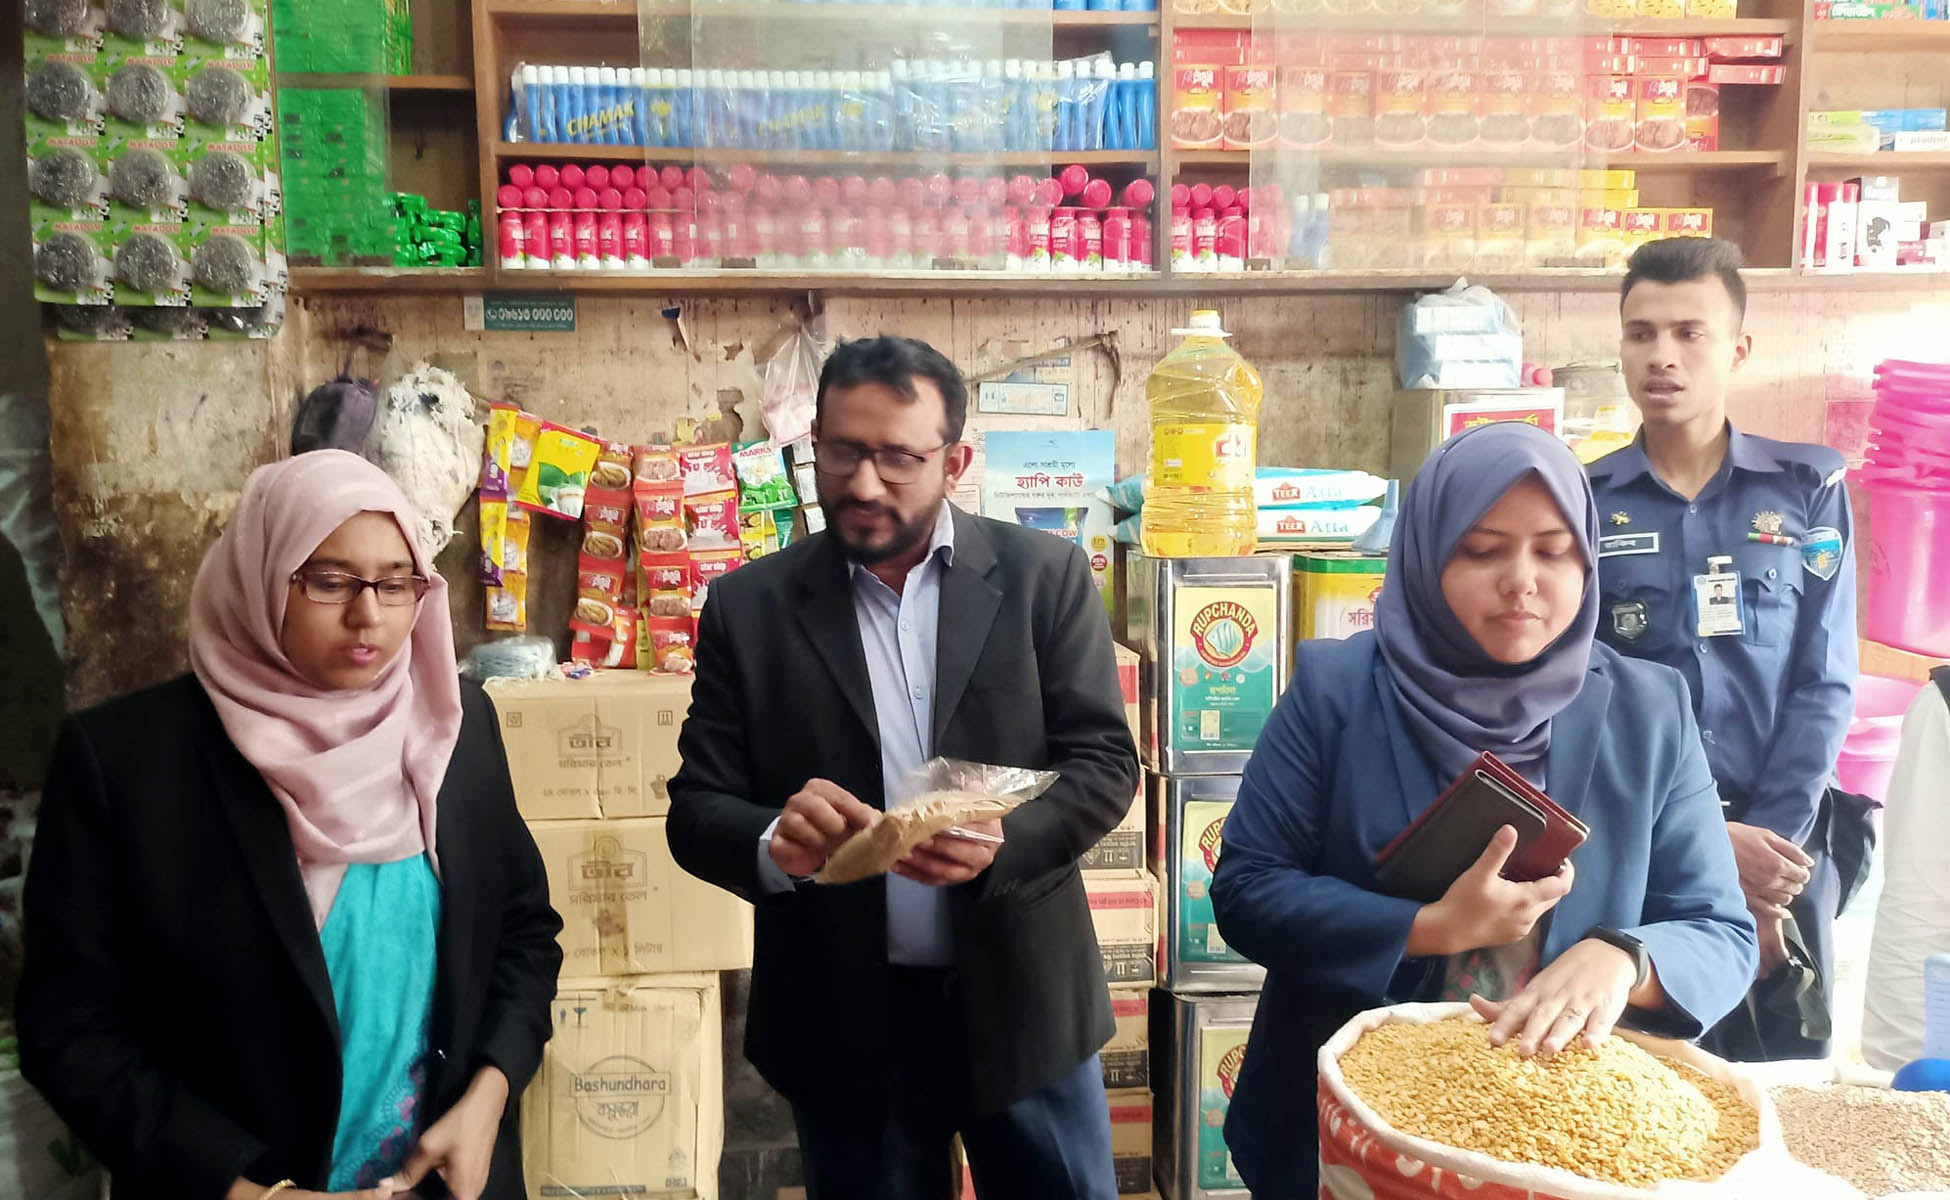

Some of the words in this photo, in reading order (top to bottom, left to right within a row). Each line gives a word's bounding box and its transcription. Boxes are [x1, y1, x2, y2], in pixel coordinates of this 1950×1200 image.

[567, 100, 635, 136] CHAMAK
[1016, 472, 1051, 488] হ্যাপি
[1055, 472, 1084, 488] কাউ
[1310, 520, 1349, 533] Atta
[1193, 602, 1256, 638] RUPCHANDA
[575, 1075, 666, 1092] Bashundhara
